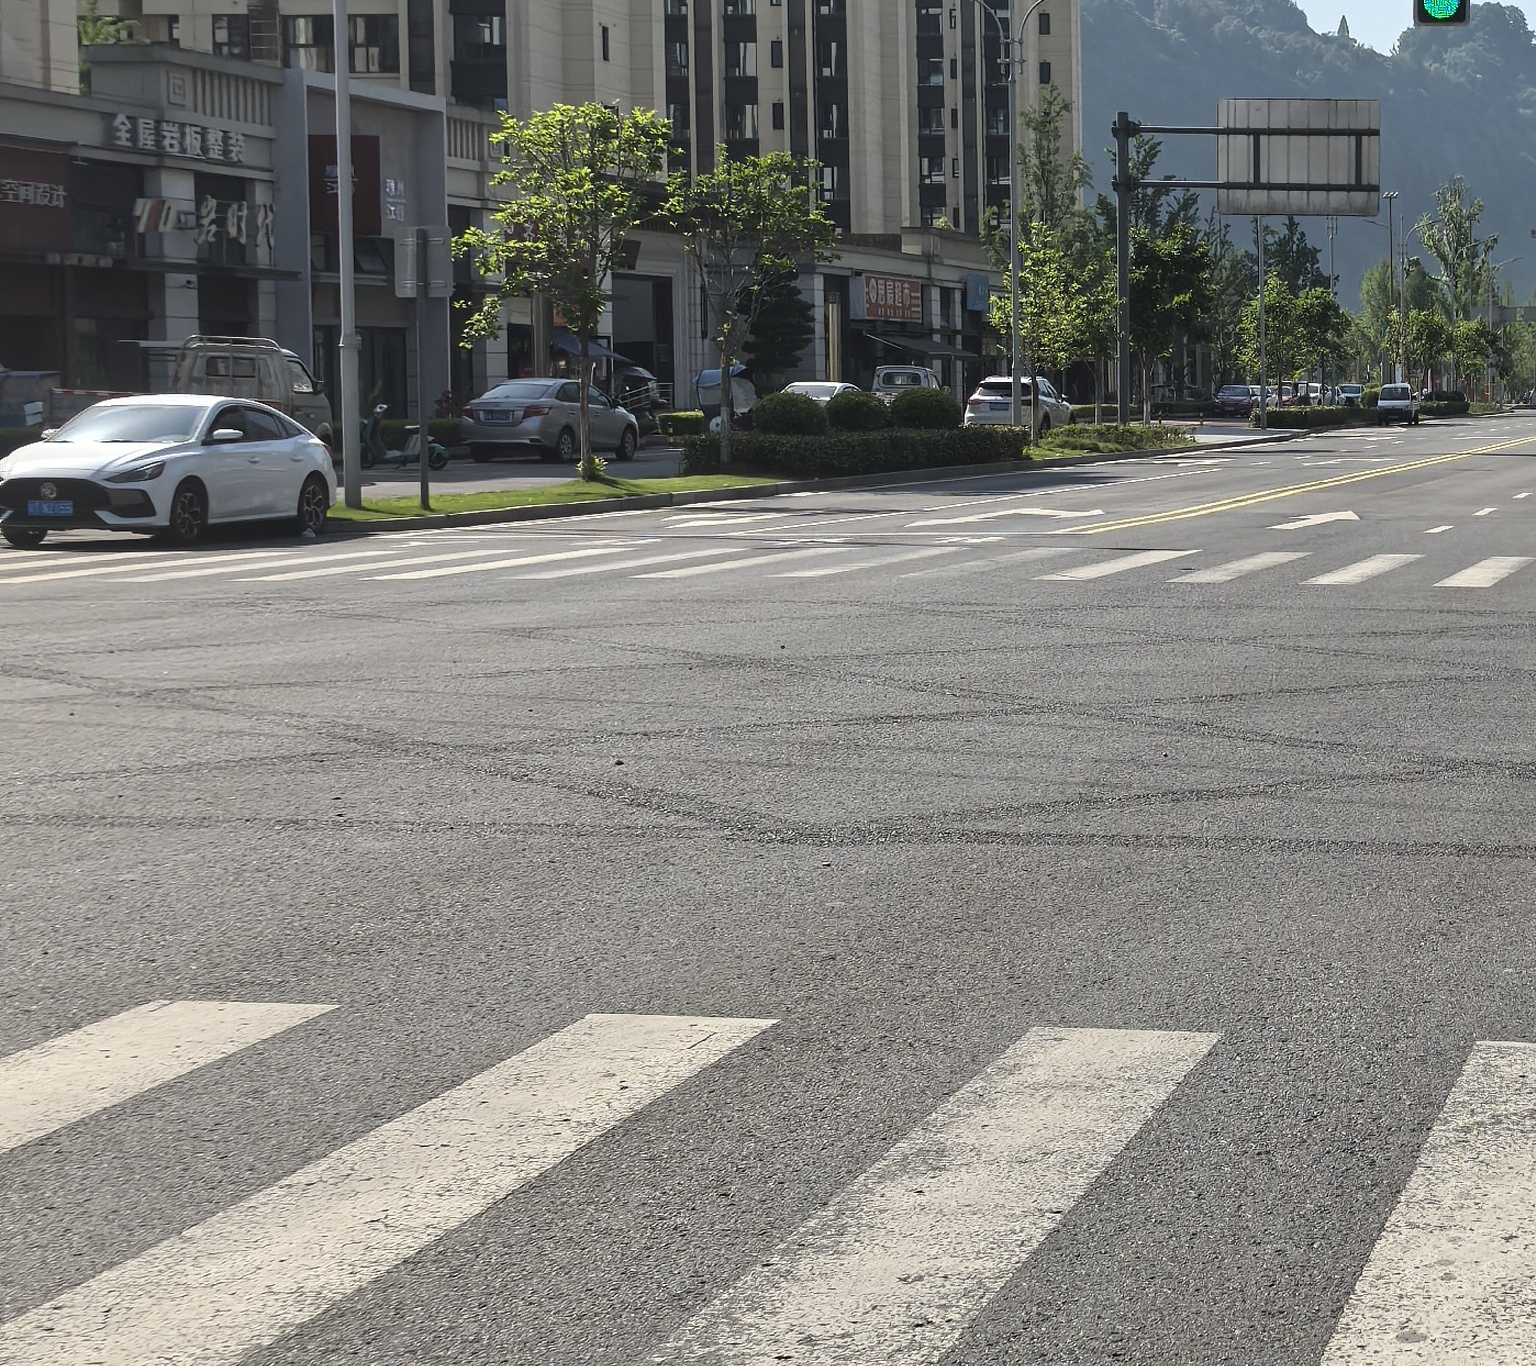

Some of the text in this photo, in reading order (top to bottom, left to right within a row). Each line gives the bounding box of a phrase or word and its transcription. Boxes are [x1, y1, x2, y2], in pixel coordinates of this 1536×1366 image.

[112, 112, 246, 164] 全屋岩板整装
